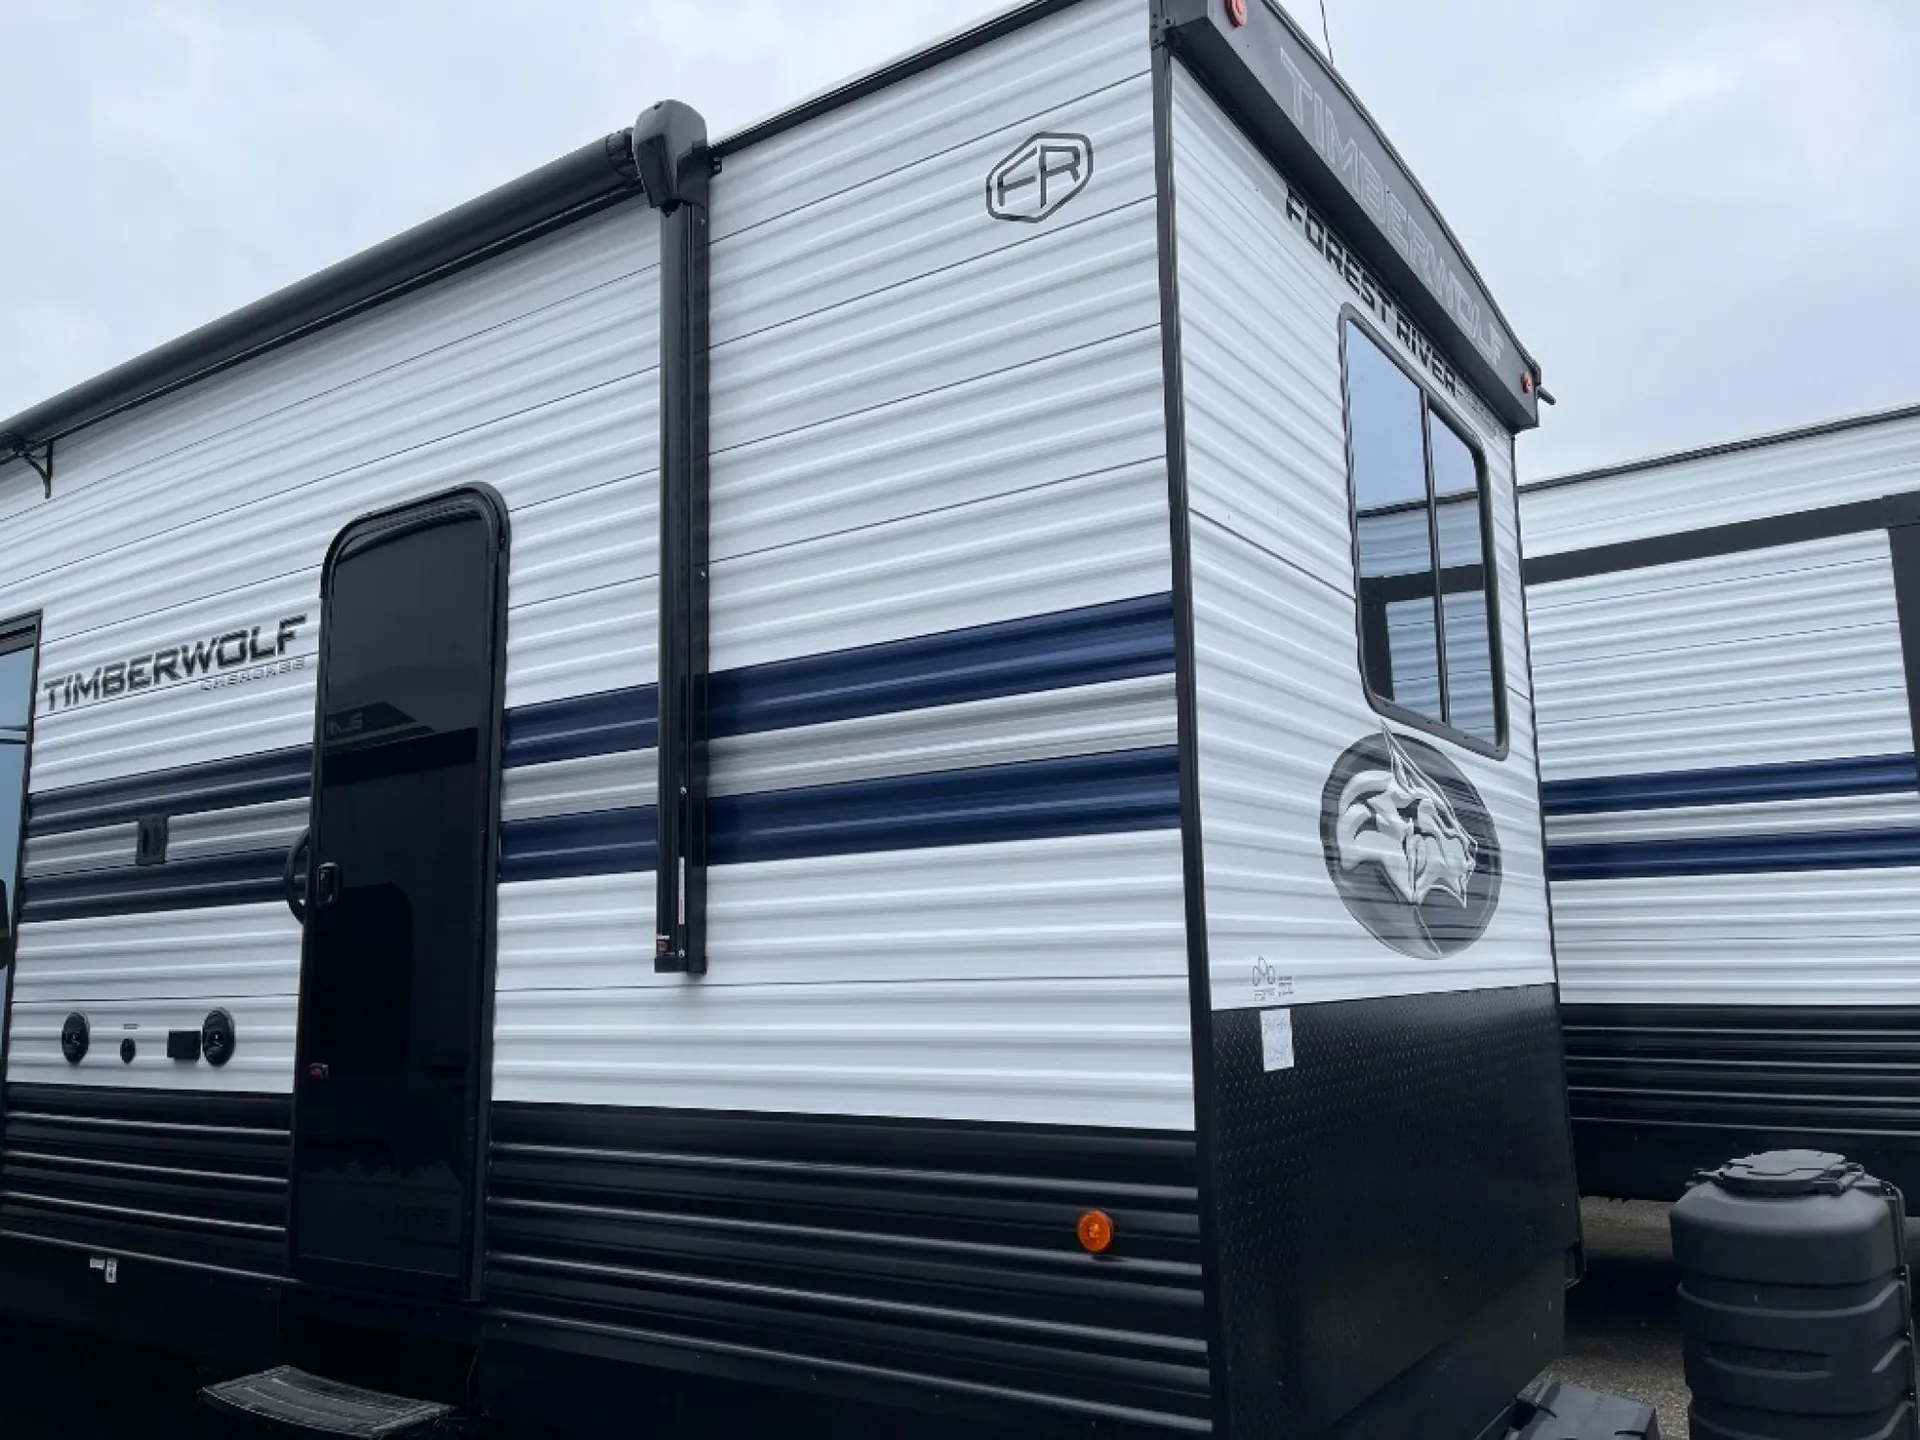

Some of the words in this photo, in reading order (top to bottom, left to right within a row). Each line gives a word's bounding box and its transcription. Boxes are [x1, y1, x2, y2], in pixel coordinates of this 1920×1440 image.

[1281, 46, 1506, 364] TIMBERWOLF
[1286, 185, 1395, 323] FOREST
[1396, 309, 1457, 397] RIVER
[43, 613, 308, 711] TIMBERWOLF
